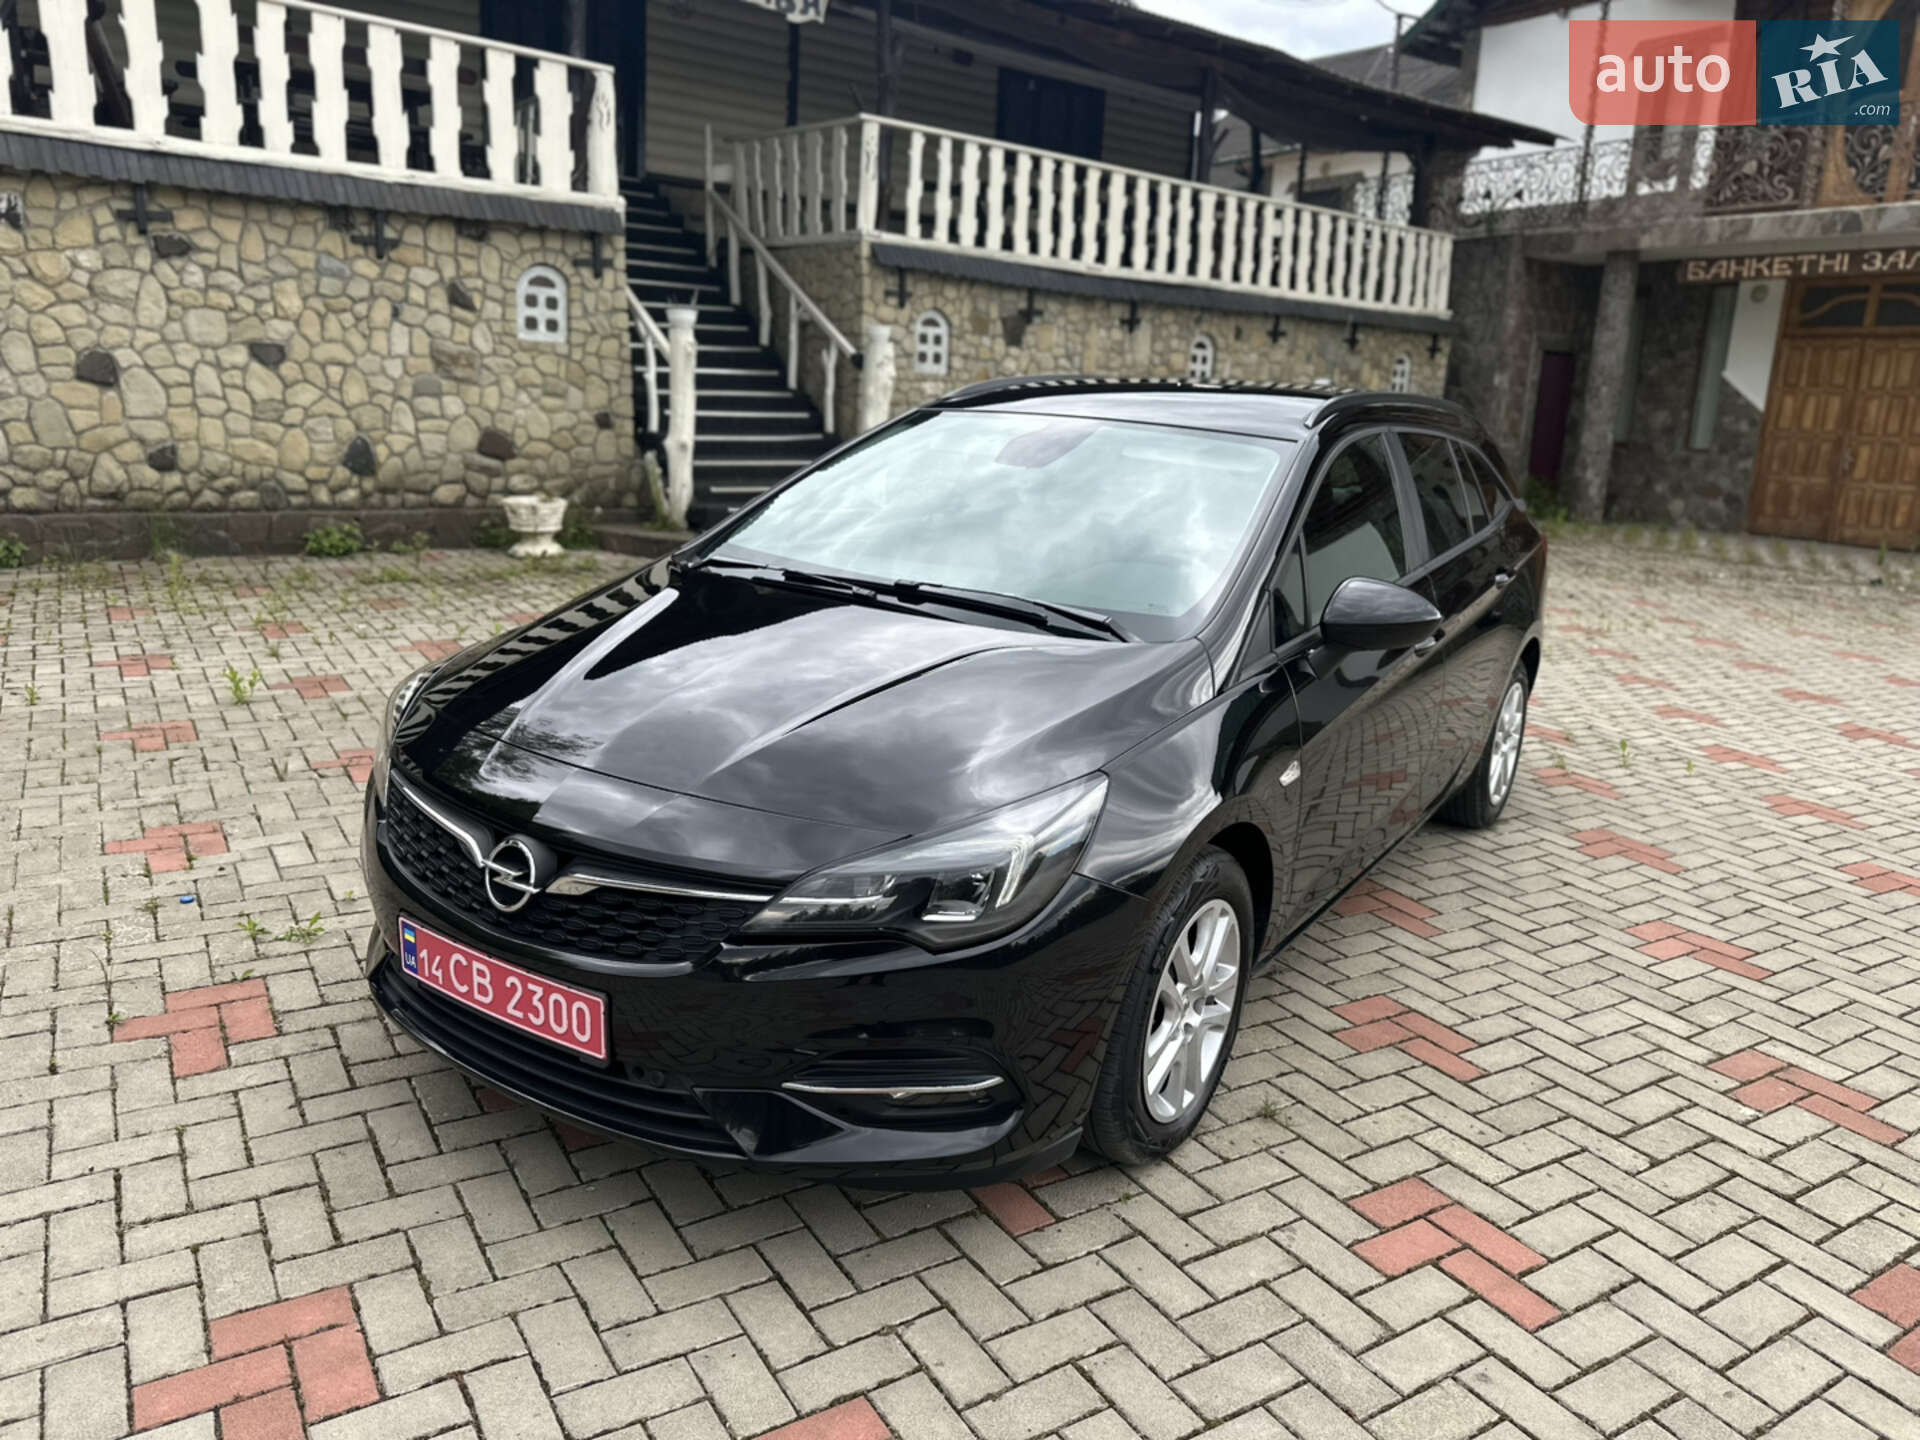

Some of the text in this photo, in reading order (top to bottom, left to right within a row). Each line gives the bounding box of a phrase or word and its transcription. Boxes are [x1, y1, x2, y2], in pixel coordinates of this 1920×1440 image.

[1686, 252, 1850, 281] БАНКЕТНІ
[404, 951, 417, 969] UA
[505, 975, 592, 1043] 2300
